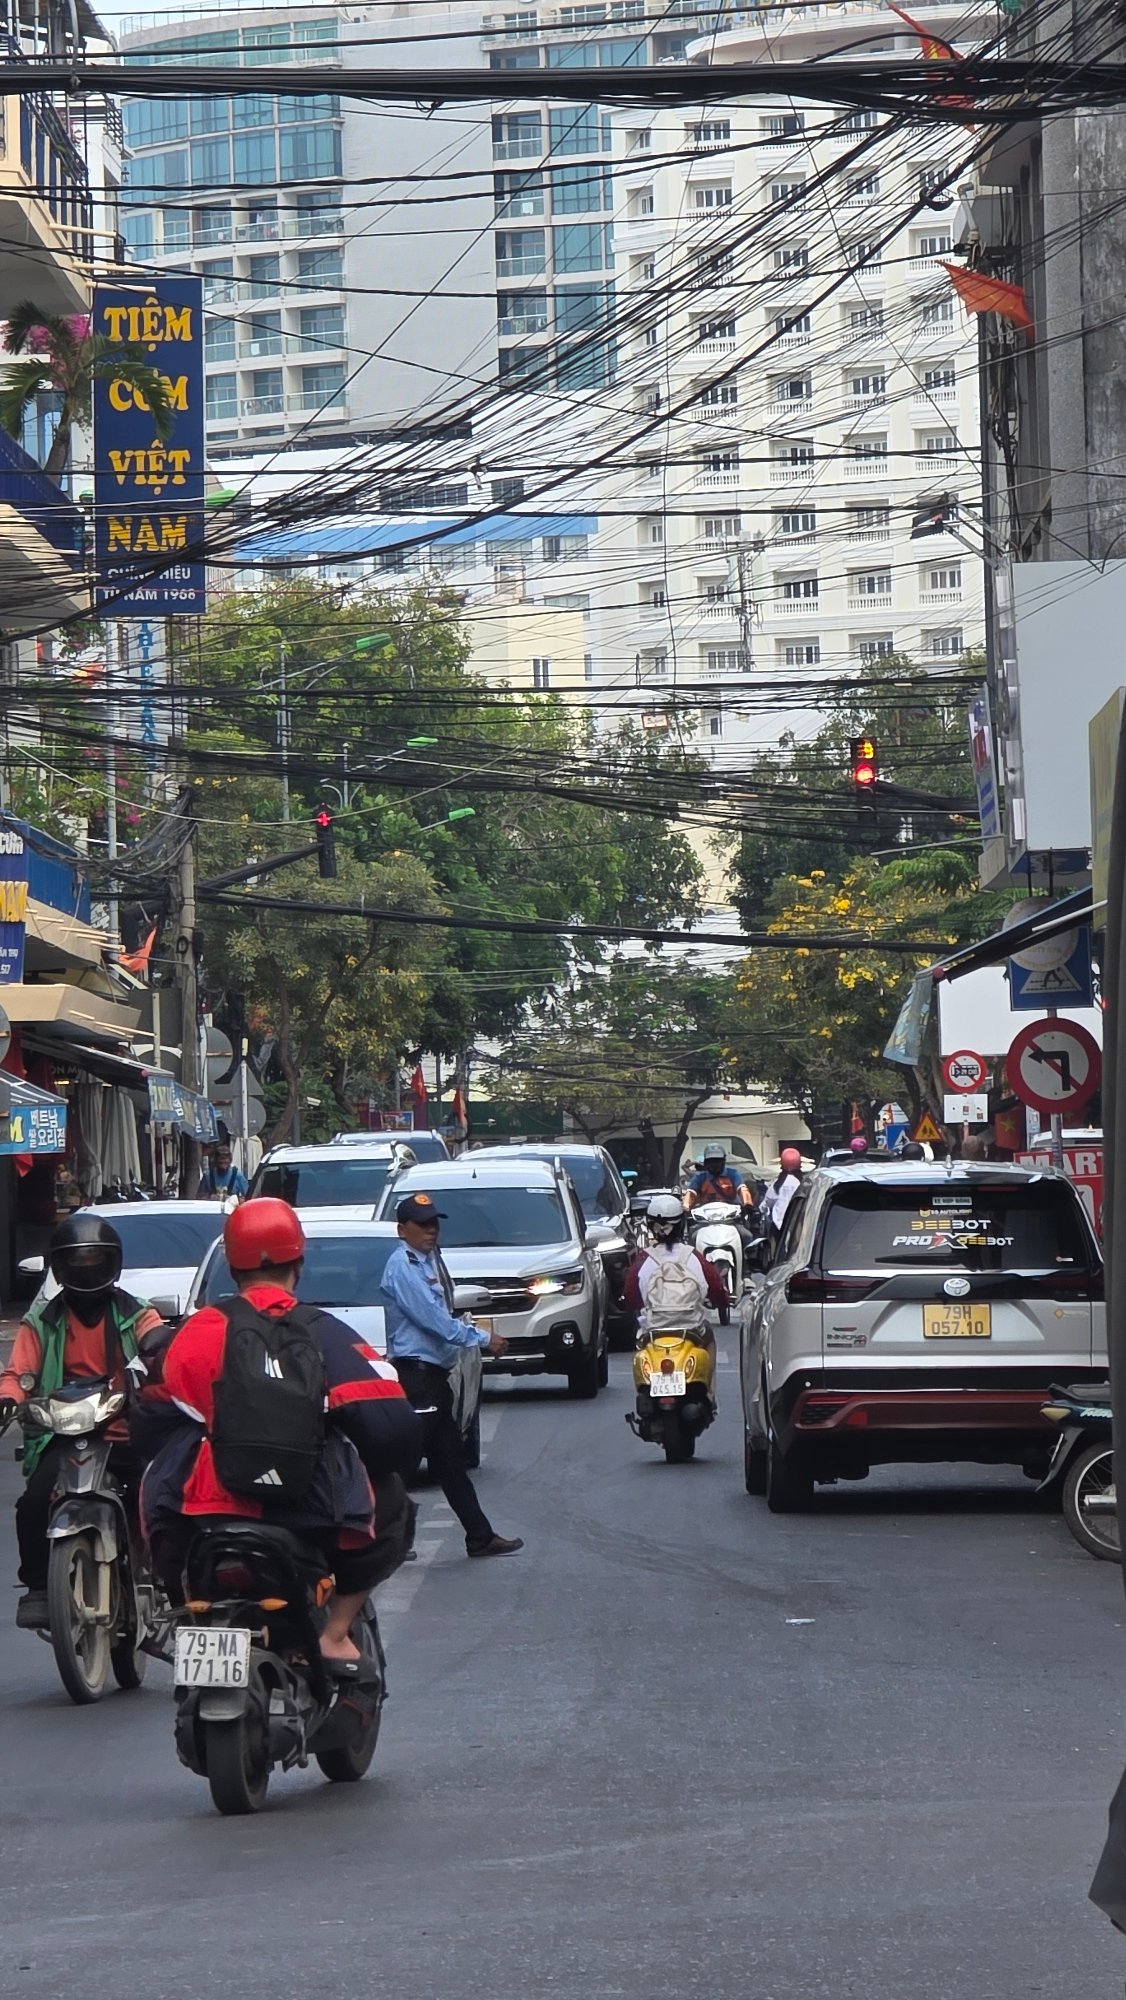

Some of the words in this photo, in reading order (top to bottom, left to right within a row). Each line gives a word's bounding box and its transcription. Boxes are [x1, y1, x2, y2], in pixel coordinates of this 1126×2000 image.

[104, 297, 193, 352] TIỆM
[108, 438, 191, 495] VIỆT
[107, 516, 188, 552] NAM
[30, 1109, 58, 1128] 베트남
[38, 1127, 66, 1147] 요리점
[911, 1220, 991, 1231] BEEBOT
[943, 1306, 972, 1320] 79H
[931, 1321, 984, 1335] 057.10
[187, 1632, 237, 1656] 79-NA
[183, 1658, 242, 1683] 171.16
